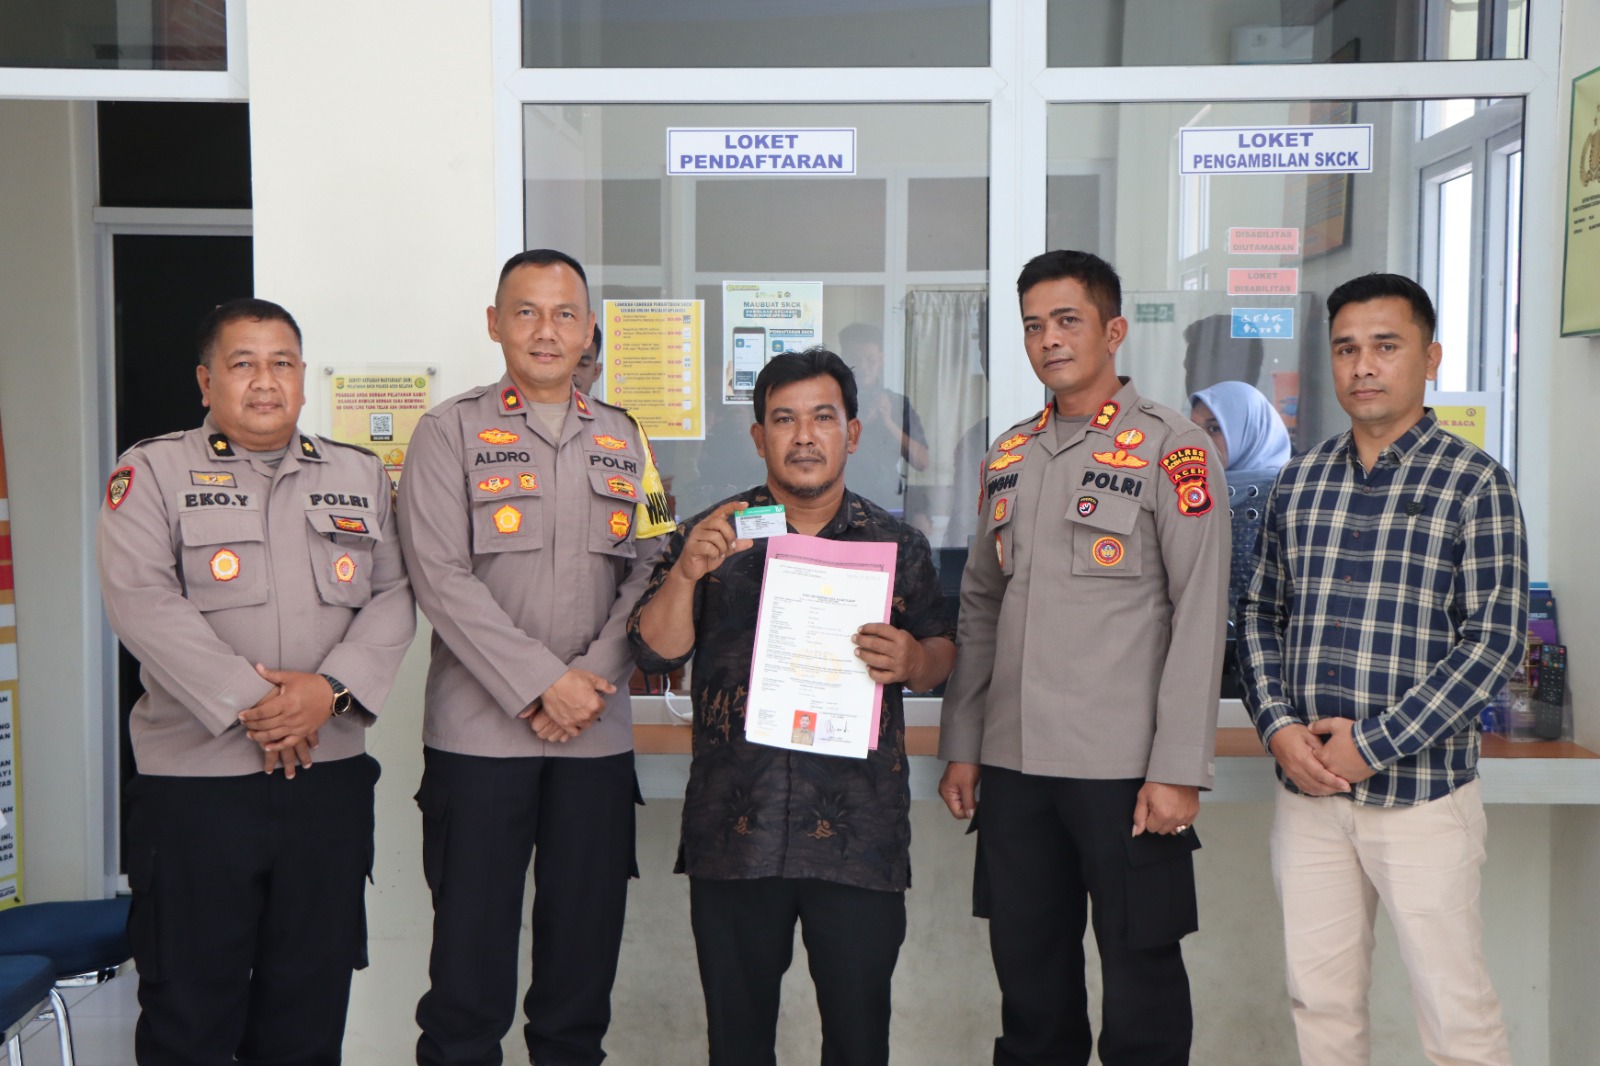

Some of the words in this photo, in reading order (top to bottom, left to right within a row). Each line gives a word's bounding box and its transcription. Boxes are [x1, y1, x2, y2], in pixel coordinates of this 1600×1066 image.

[724, 133, 799, 150] LOKET
[1237, 132, 1314, 149] LOKET
[679, 153, 844, 169] PENDAFTARAN
[1193, 153, 1310, 169] PENGAMBILAN
[1314, 151, 1359, 167] SKCK
[1235, 231, 1293, 239] DISABILITAS
[1232, 243, 1295, 251] DIUTAMAKAN
[1247, 272, 1278, 280] LOKET
[1234, 285, 1291, 293] DISABILITAS
[474, 451, 531, 466] ALDRO
[589, 454, 637, 474] POLRI
[1162, 448, 1205, 467] POLRES
[1174, 468, 1205, 481] ACEH
[1081, 471, 1142, 498] POLRI
[185, 492, 249, 508] EKO.Y
[309, 493, 369, 509] POLRI
